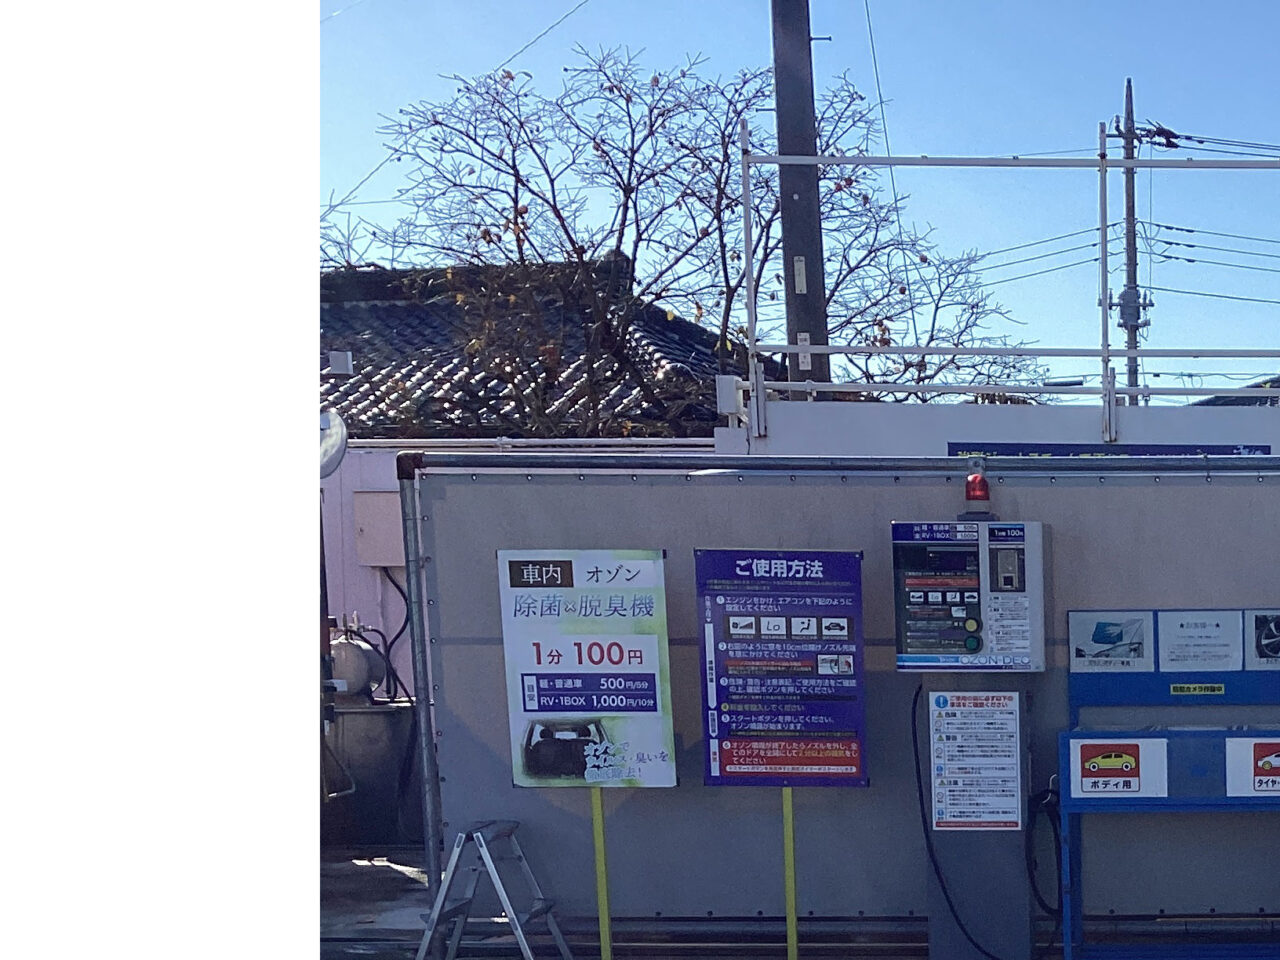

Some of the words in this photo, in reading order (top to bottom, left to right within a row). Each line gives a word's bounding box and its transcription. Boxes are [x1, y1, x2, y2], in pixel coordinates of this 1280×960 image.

[520, 564, 562, 584] 車内
[586, 565, 641, 583] オゾン
[735, 559, 824, 578] ご使用方法
[513, 593, 655, 618] 除菌×脱臭機
[532, 642, 563, 665] 1分
[573, 641, 643, 665] 100円
[540, 696, 586, 707] RV・1BOX
[1091, 780, 1132, 789] ボディ用
